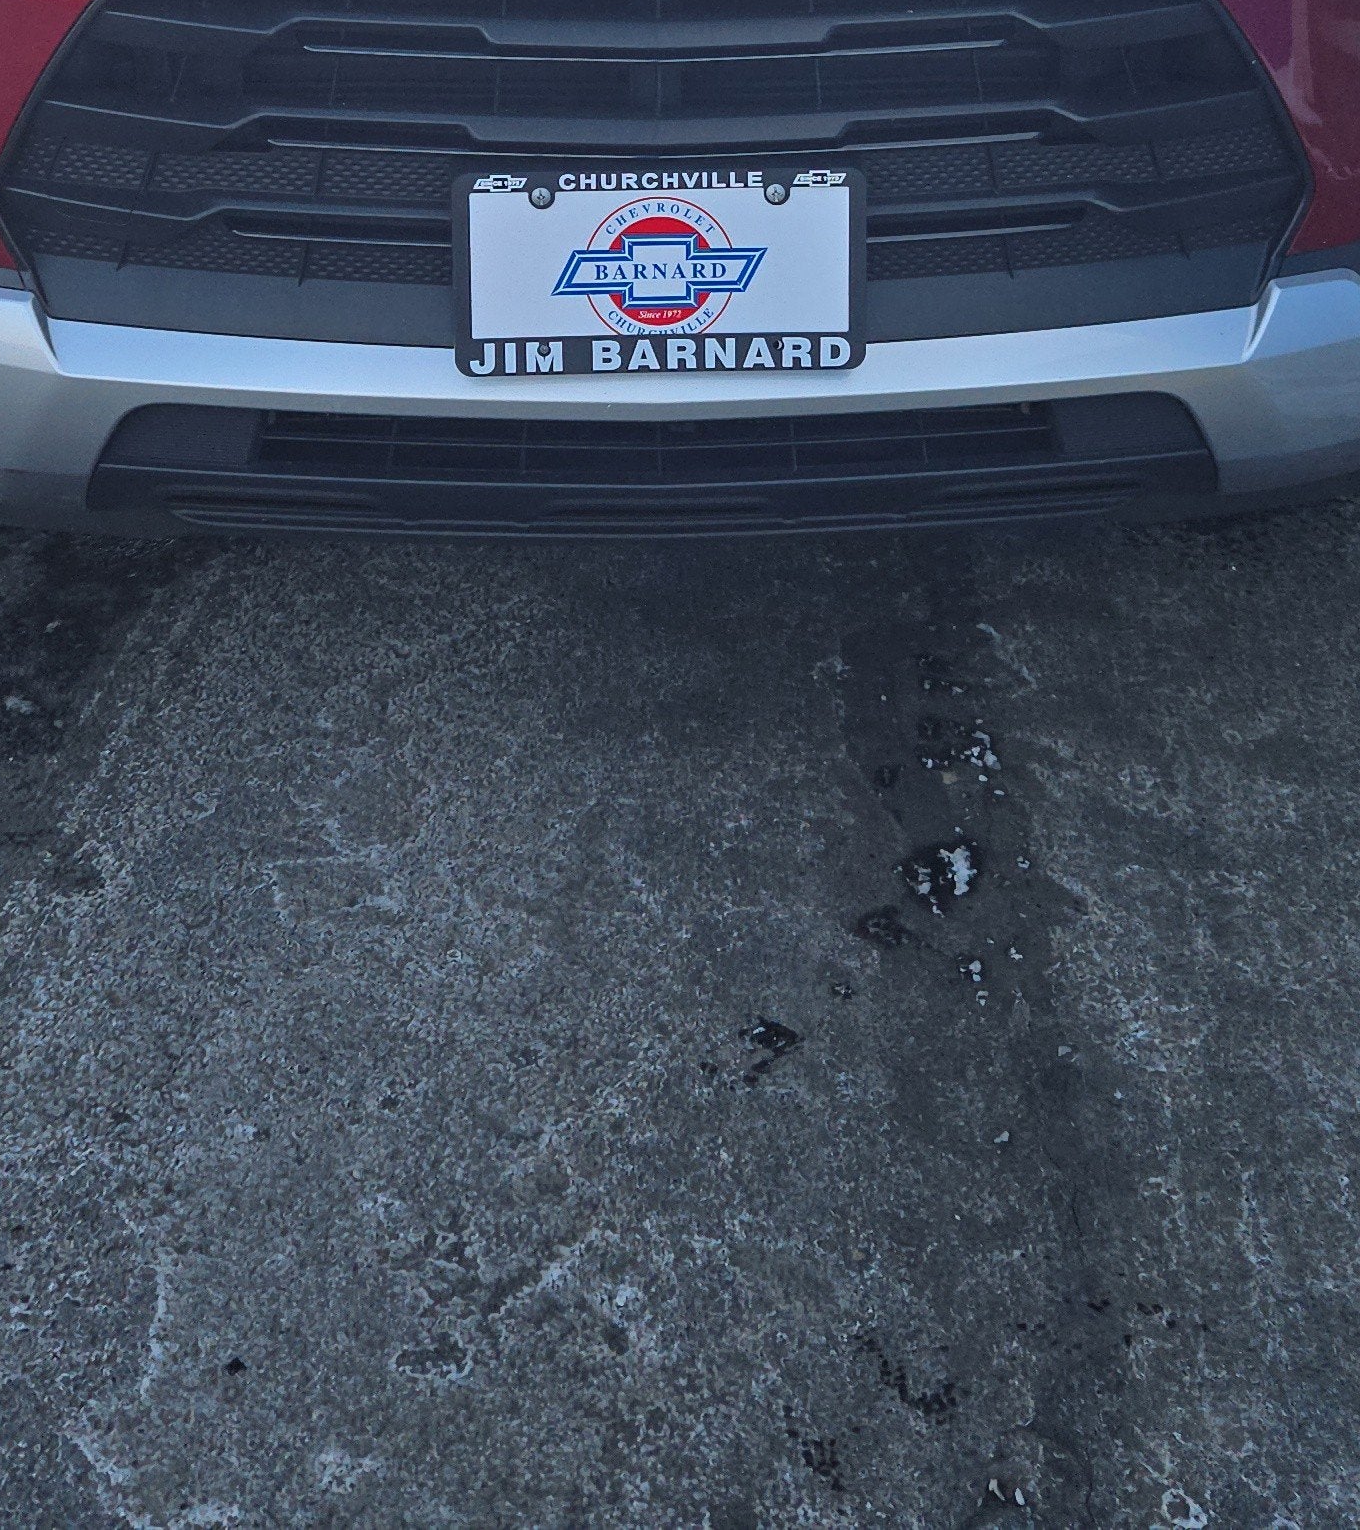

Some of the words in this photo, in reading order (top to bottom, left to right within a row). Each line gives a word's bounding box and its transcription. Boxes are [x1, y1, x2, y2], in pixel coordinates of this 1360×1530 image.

[558, 171, 763, 191] CHURCHVILLE
[605, 202, 715, 235] CHEVROLET
[594, 262, 727, 281] BARNARD
[637, 310, 661, 319] Since
[469, 341, 564, 375] JIM
[592, 336, 851, 371] BARNARD
